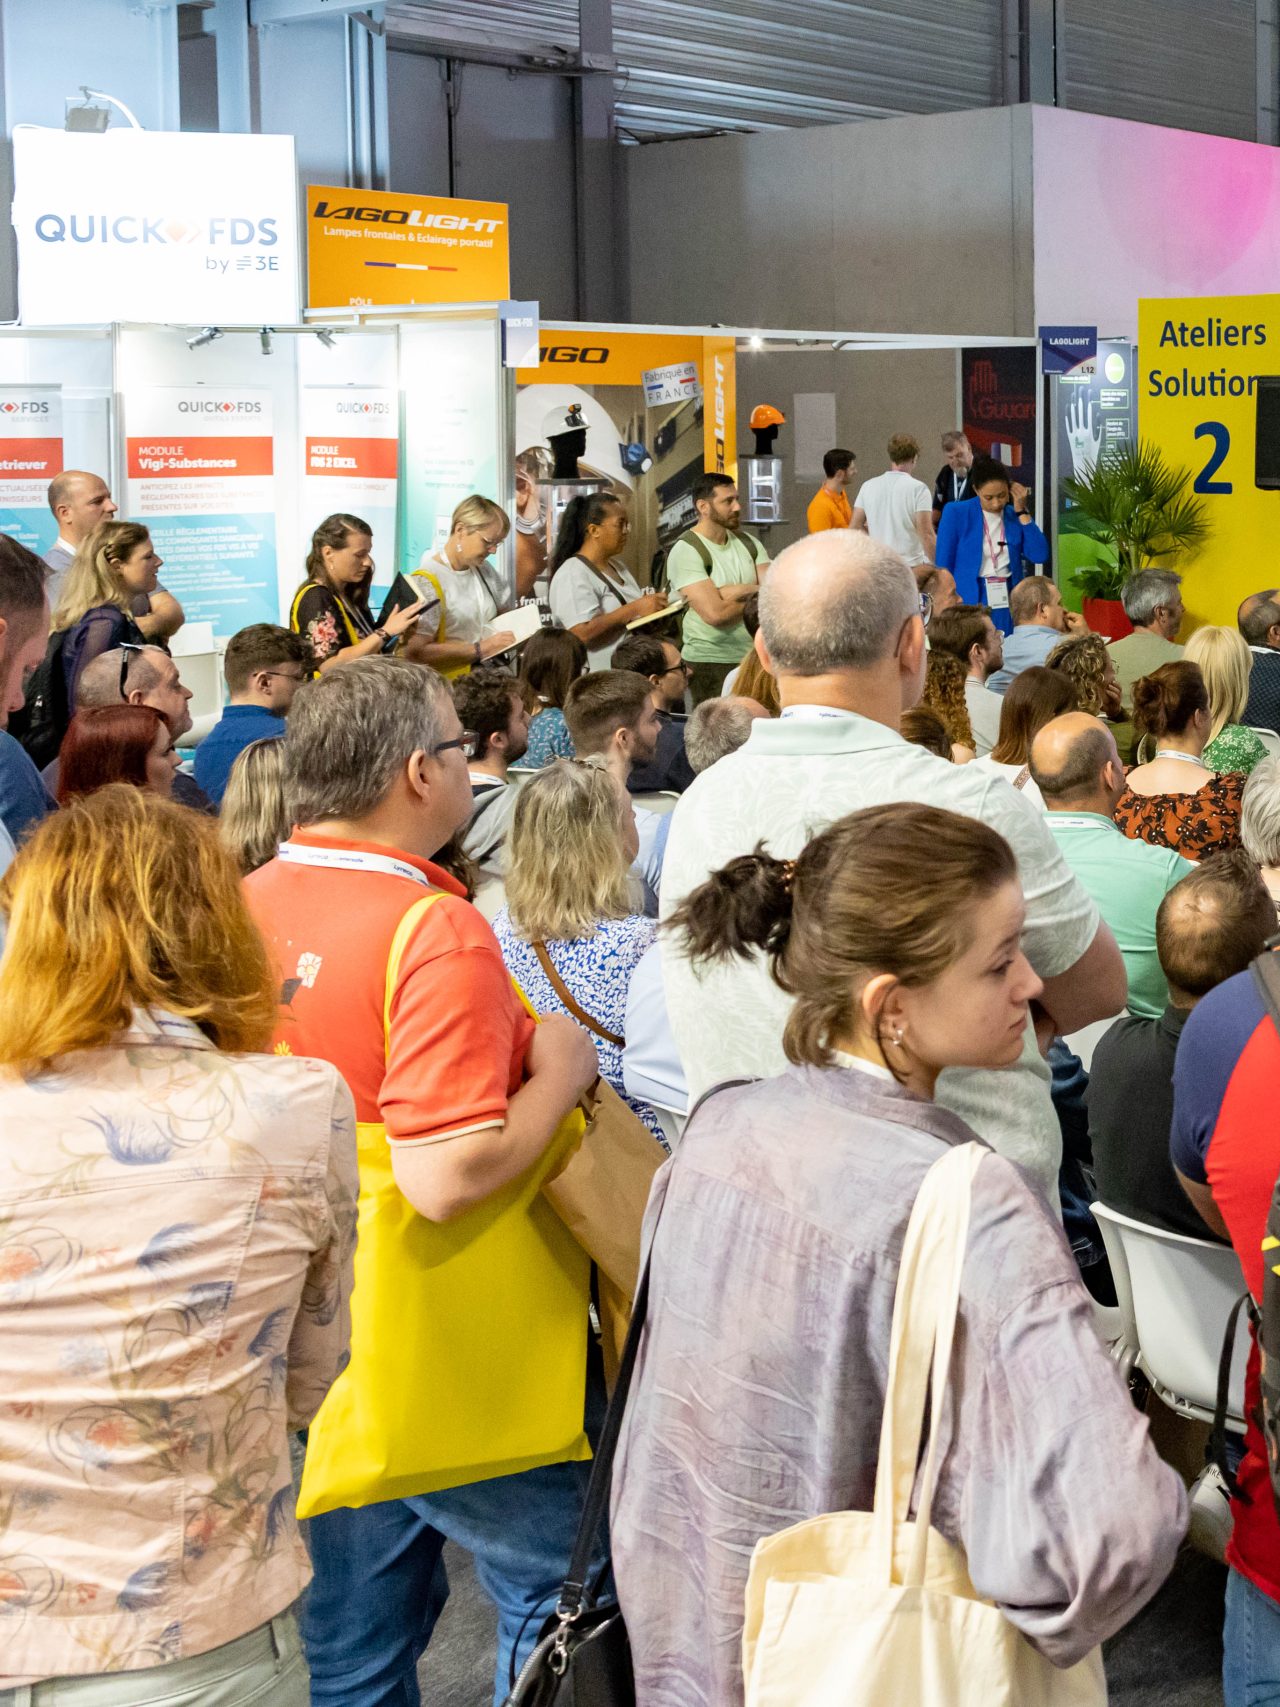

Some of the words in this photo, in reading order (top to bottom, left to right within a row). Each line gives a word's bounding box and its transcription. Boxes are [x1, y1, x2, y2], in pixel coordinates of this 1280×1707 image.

[314, 202, 504, 233] LAGOLIGHT
[35, 214, 167, 244] QUICK
[209, 218, 278, 247] FDS
[324, 226, 362, 239] Lampes
[364, 229, 406, 242] frontales
[408, 233, 415, 242] &
[417, 233, 458, 247] Eclairage
[460, 239, 494, 249] portatif
[206, 256, 230, 274] by
[255, 256, 280, 271] 3E
[1159, 318, 1267, 348] Ateliers
[1049, 338, 1090, 346] LAGOLIGHT
[684, 366, 696, 375] en
[1081, 366, 1095, 374] L12
[648, 383, 699, 401] FRANCE
[21, 402, 49, 414] FDS
[178, 401, 223, 413] QUICK
[237, 402, 262, 413] FDS
[336, 403, 363, 414] QUICK
[373, 403, 389, 414] FDS
[139, 446, 184, 456] MODULE
[311, 445, 340, 455] MODULE
[1193, 420, 1233, 494] 2
[138, 458, 237, 471] Vigi-Substances
